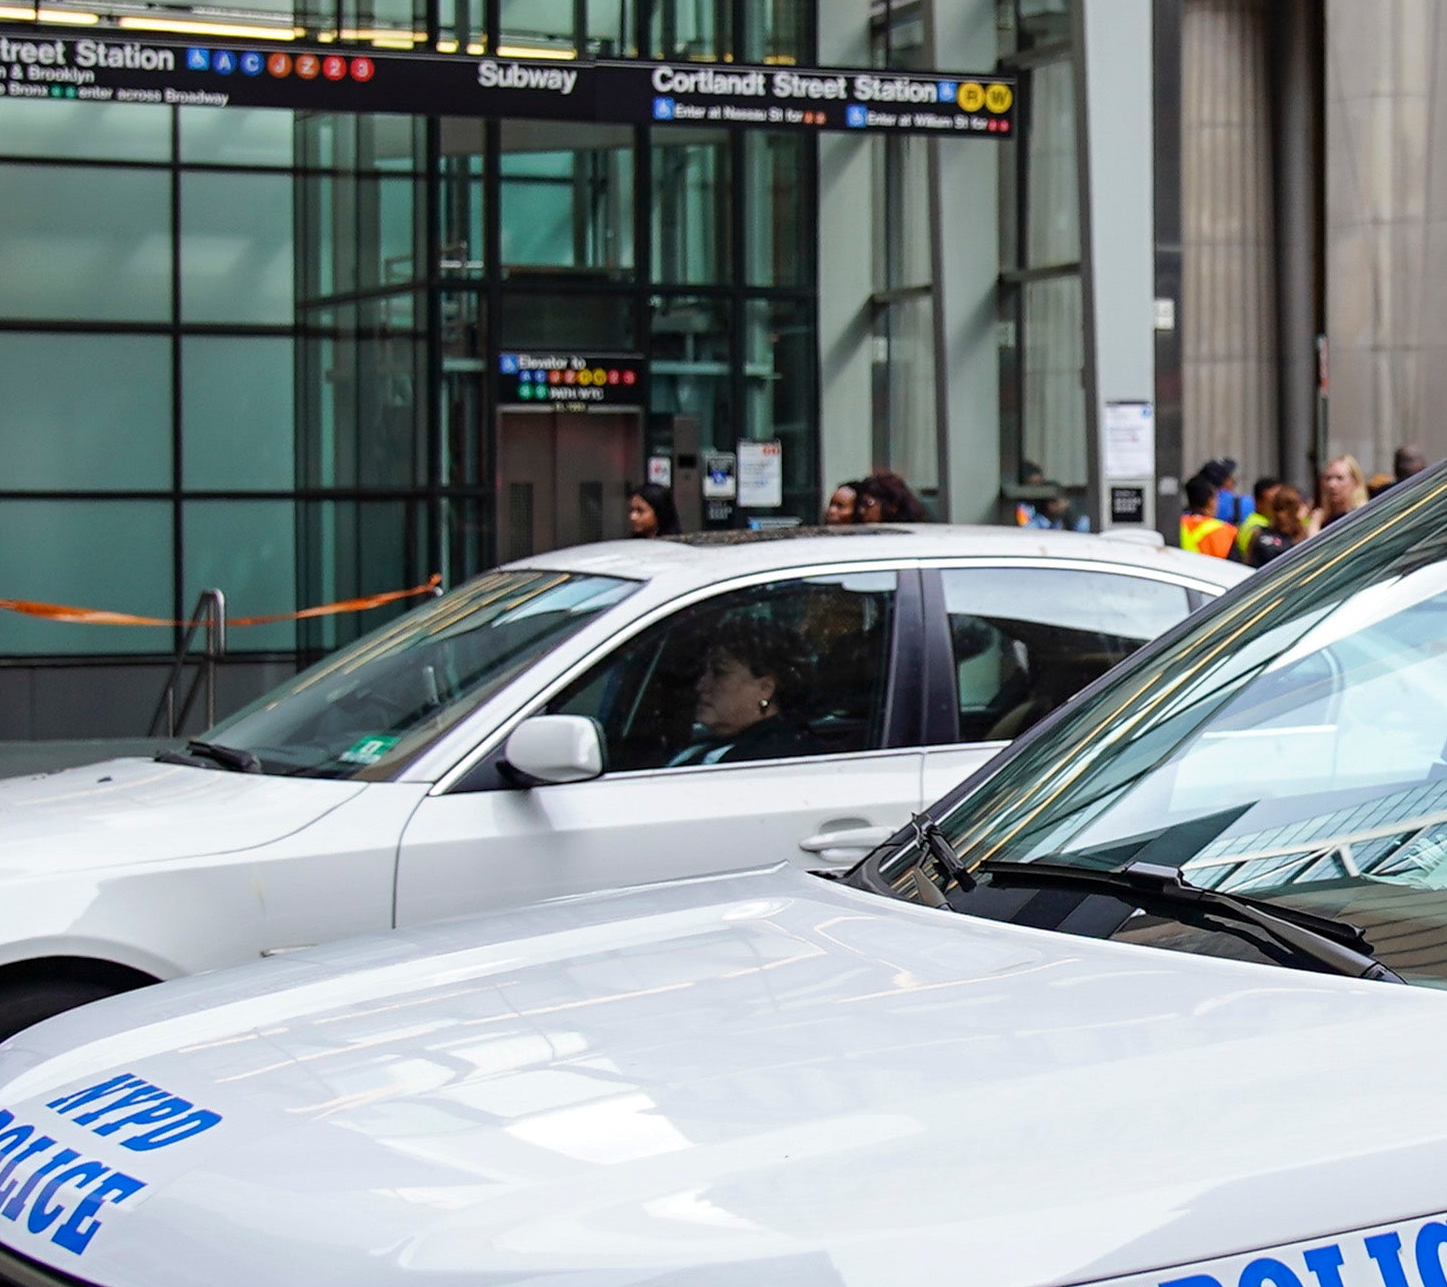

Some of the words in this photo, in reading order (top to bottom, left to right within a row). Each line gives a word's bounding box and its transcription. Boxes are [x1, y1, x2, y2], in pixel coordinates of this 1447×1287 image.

[75, 38, 175, 71] Station
[10, 63, 24, 80] &
[27, 63, 96, 85] Brooklyn
[478, 60, 577, 95] Subway
[653, 66, 766, 97] Cortlandt
[772, 70, 848, 100] Street
[853, 75, 938, 104] Station
[164, 86, 229, 108] Broadway
[519, 354, 568, 370] Elevator
[571, 355, 586, 370] to
[46, 1073, 223, 1153] NYPD
